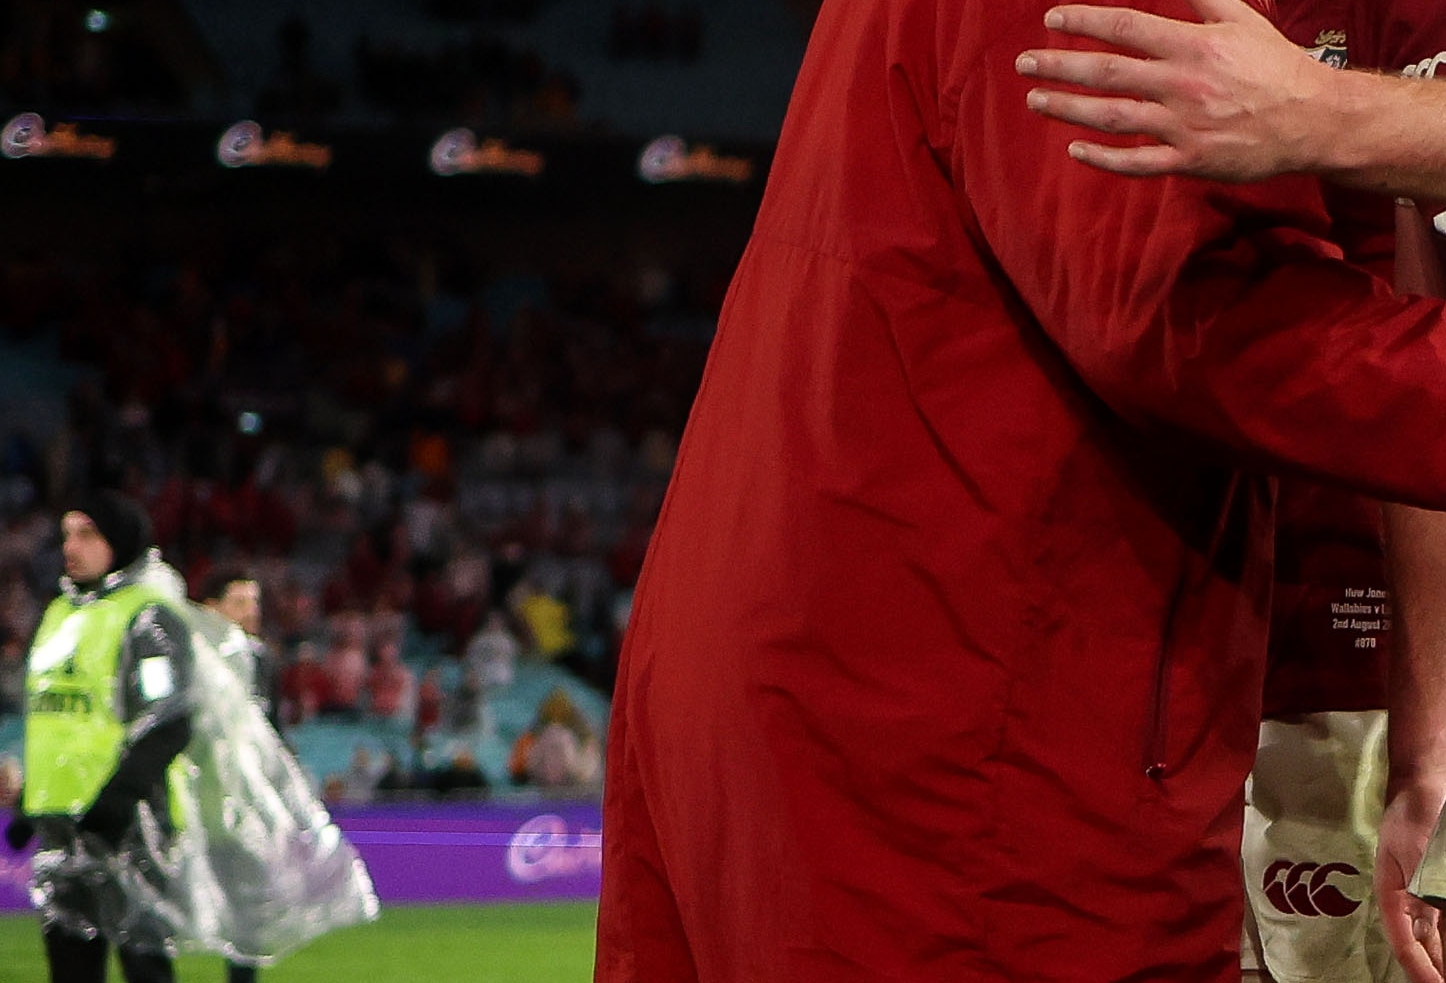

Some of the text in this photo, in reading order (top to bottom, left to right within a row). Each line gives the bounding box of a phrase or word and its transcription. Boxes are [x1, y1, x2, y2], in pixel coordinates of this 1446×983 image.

[1331, 602, 1373, 614] Wallabies
[1374, 604, 1381, 614] v
[1332, 618, 1349, 629] 2nd
[1350, 619, 1381, 632] August
